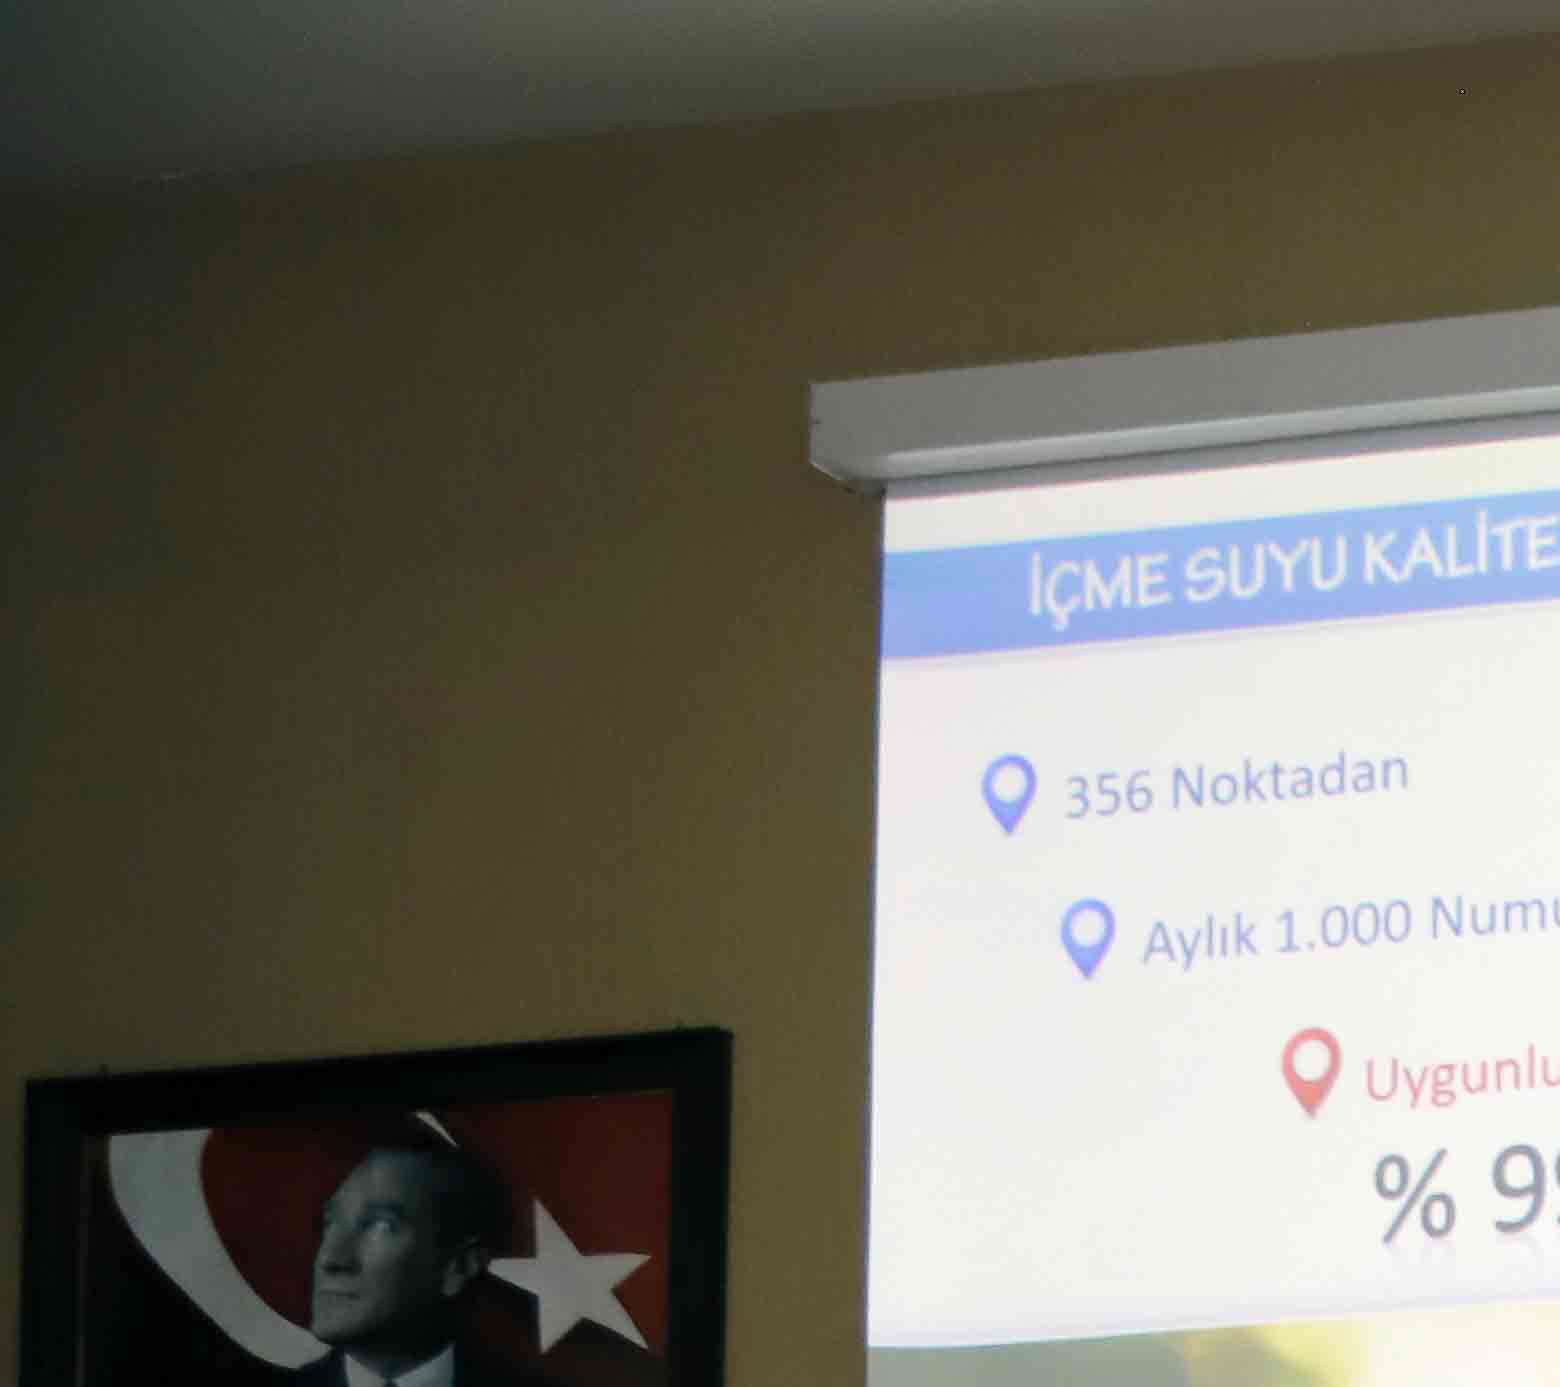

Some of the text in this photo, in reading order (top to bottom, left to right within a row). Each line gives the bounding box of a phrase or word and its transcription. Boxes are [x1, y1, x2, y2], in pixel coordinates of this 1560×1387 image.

[1030, 552, 1170, 632] İÇME
[1185, 536, 1347, 601] SUYU
[1065, 751, 1410, 819] 356 Noktadan
[1143, 913, 1258, 971] Aylık
[1276, 899, 1412, 954] 1.000
[1373, 1147, 1457, 1244] %
